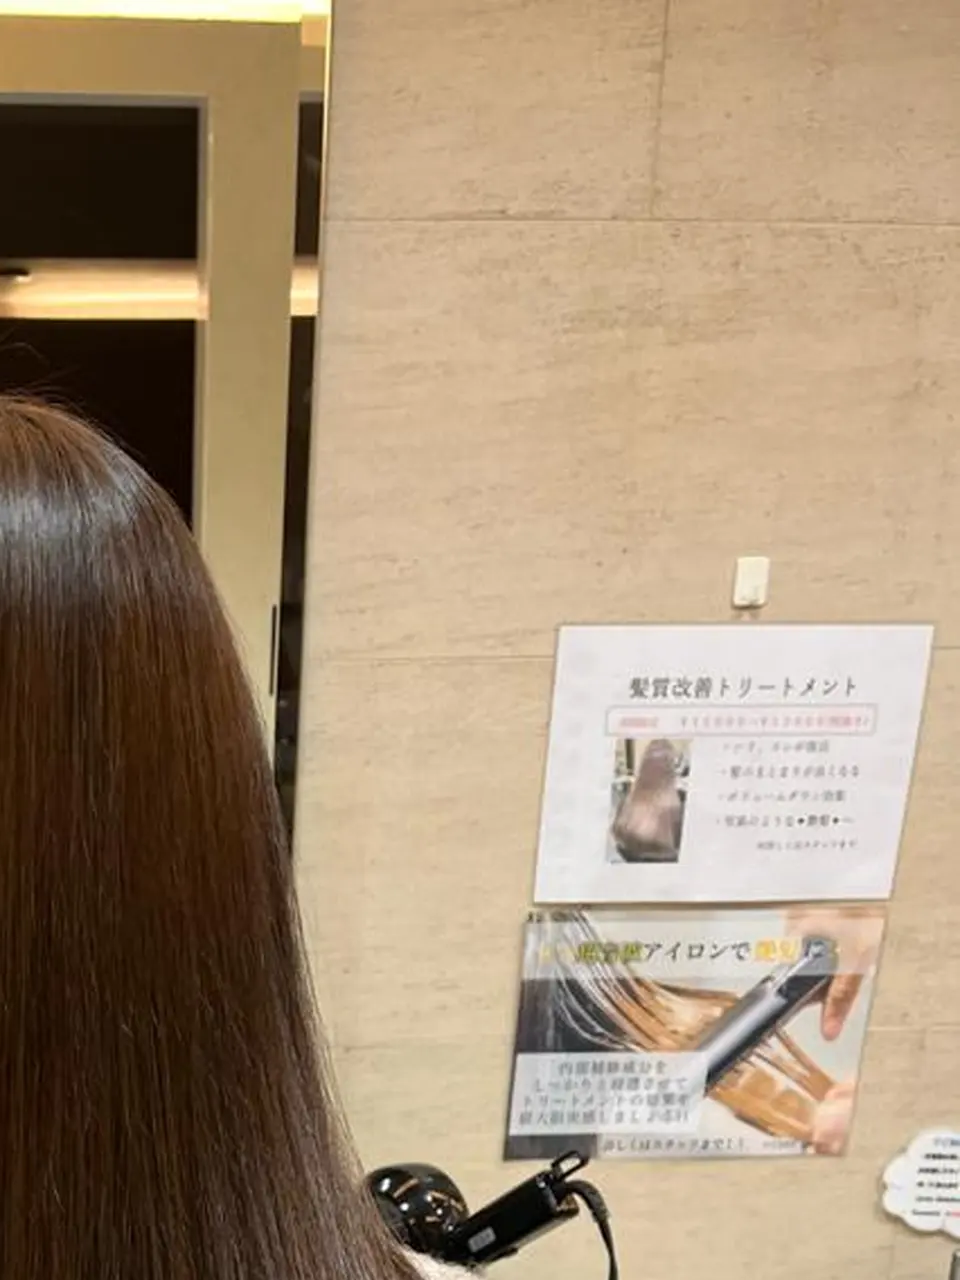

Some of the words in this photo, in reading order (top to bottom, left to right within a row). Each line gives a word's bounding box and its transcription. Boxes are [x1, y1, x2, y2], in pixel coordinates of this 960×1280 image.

[629, 676, 856, 699] 髪質改善トリートメント
